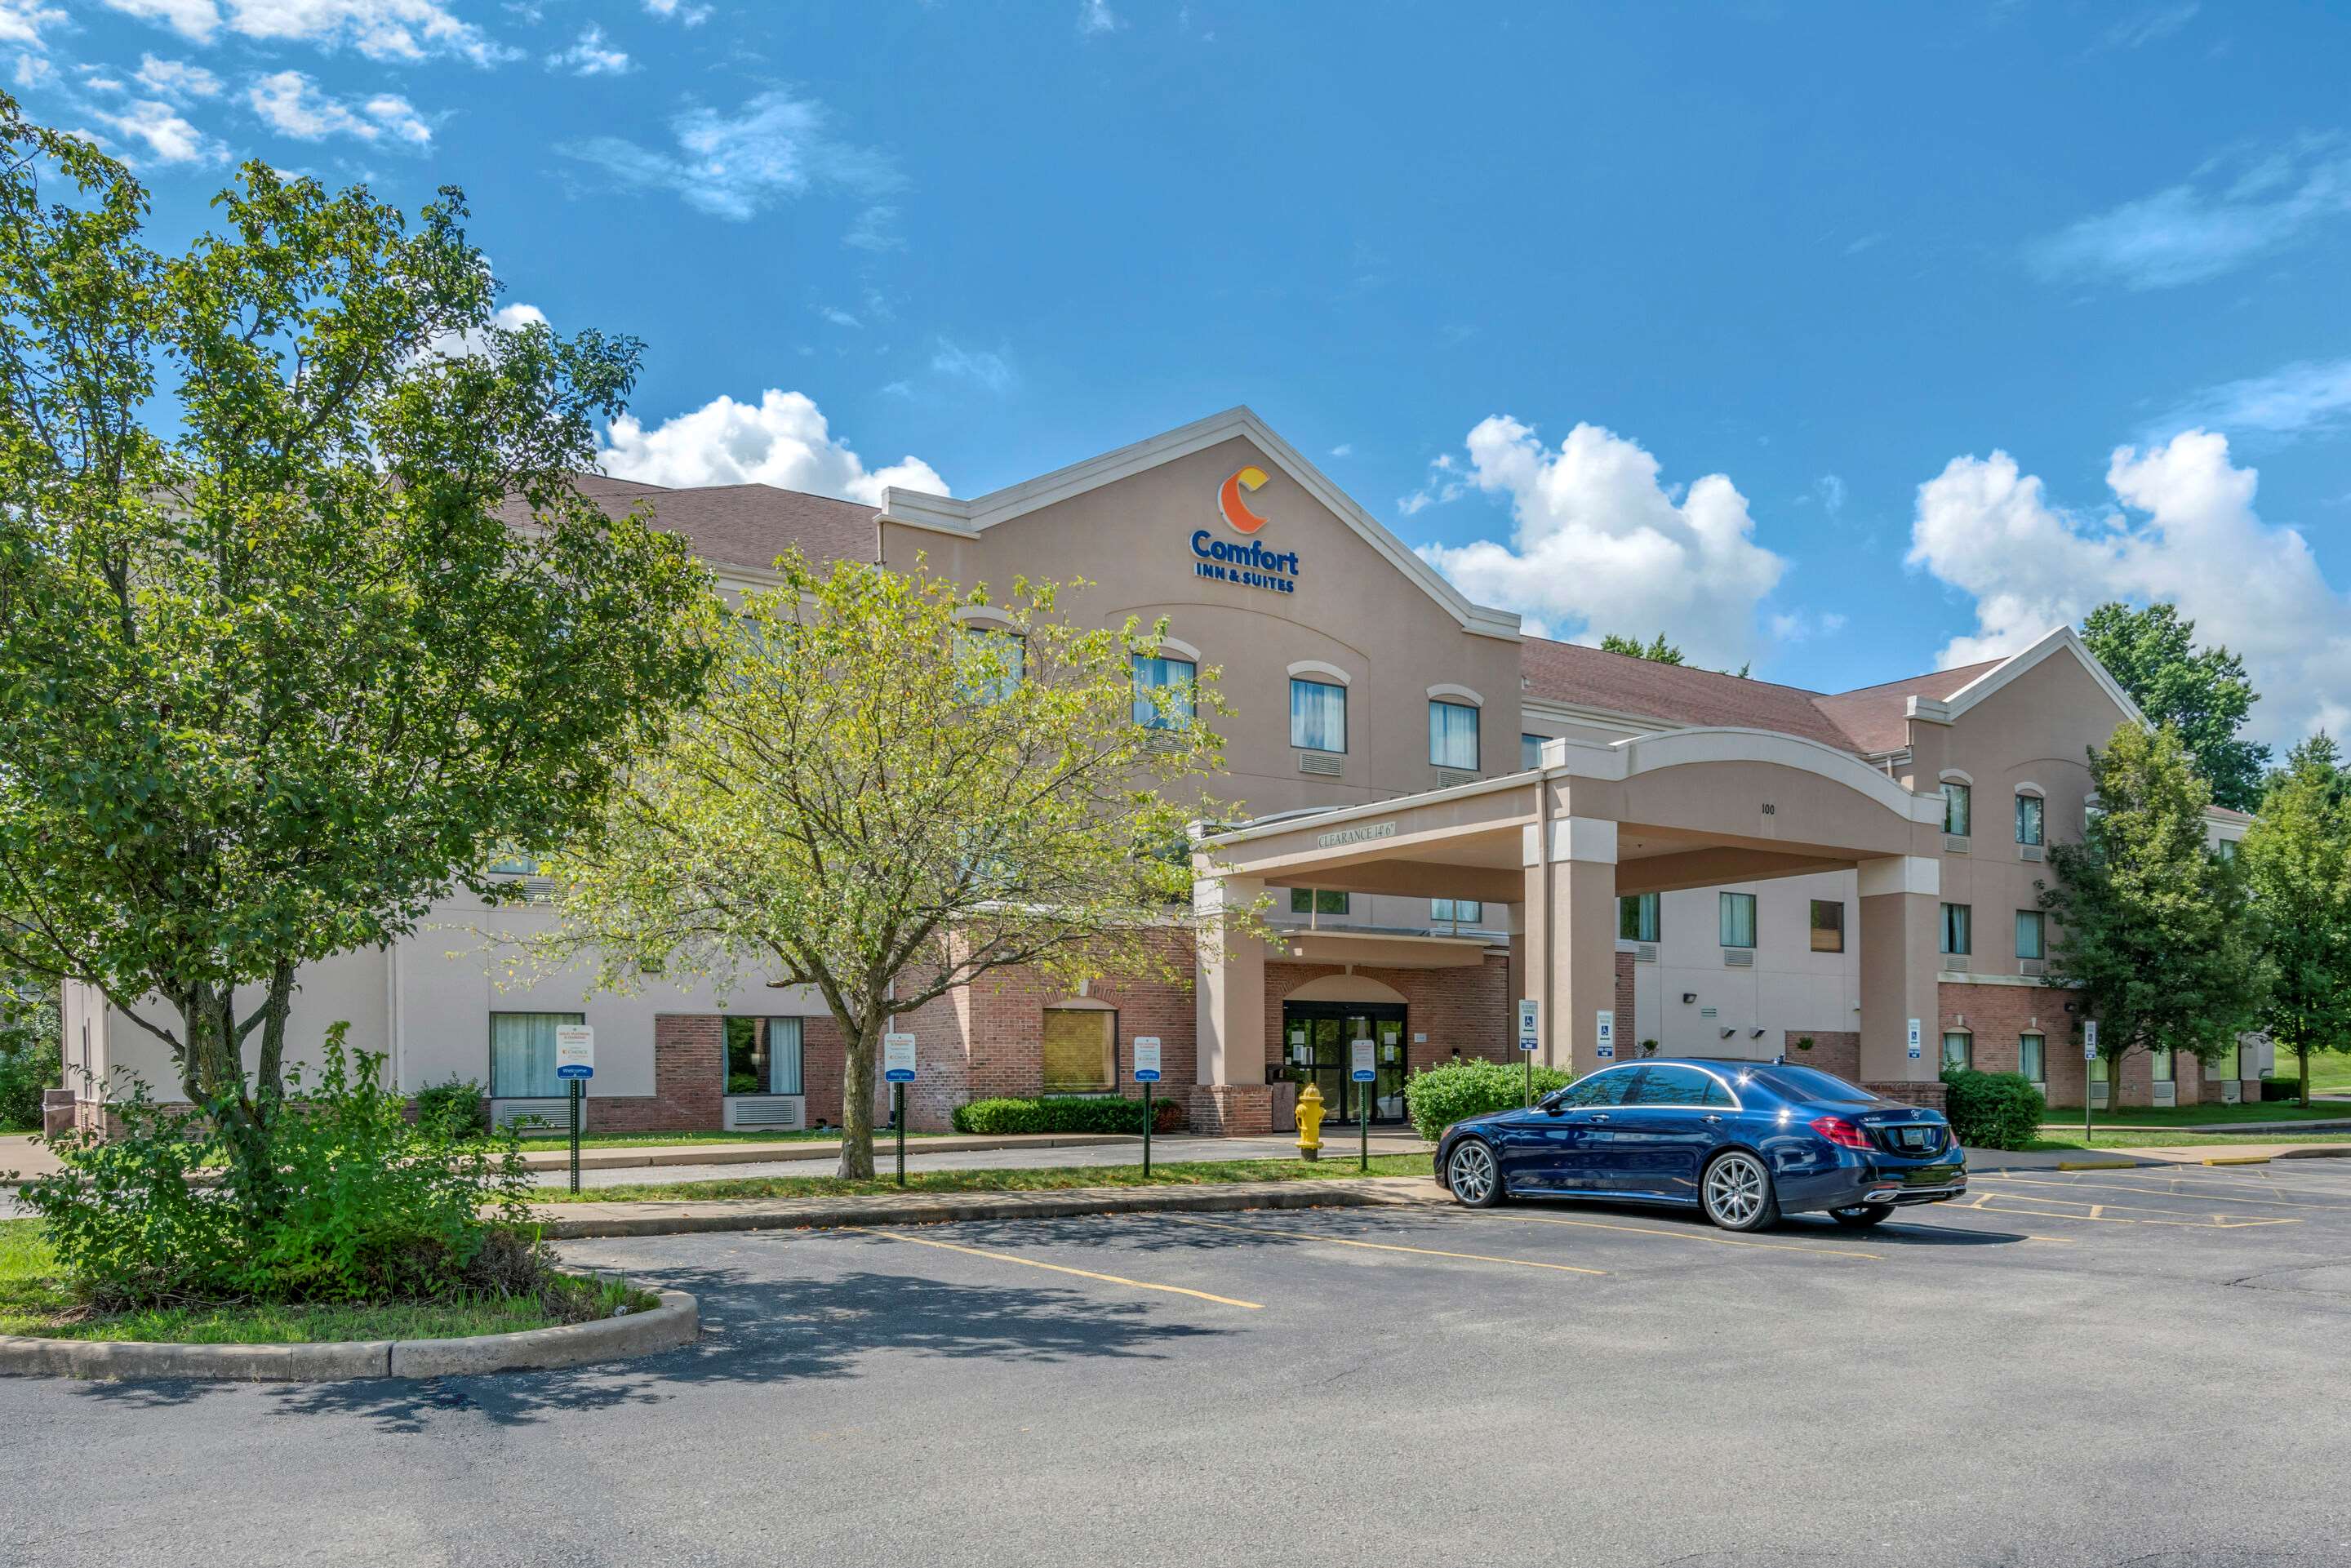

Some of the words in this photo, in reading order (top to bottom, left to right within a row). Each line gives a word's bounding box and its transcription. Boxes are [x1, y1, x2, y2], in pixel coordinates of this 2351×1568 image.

[1189, 530, 1299, 575] Comfort
[1194, 562, 1225, 580] INN
[1228, 569, 1240, 583] &
[1242, 572, 1295, 594] SUITES
[1762, 803, 1775, 815] 100
[1318, 827, 1372, 848] CLEARANCE
